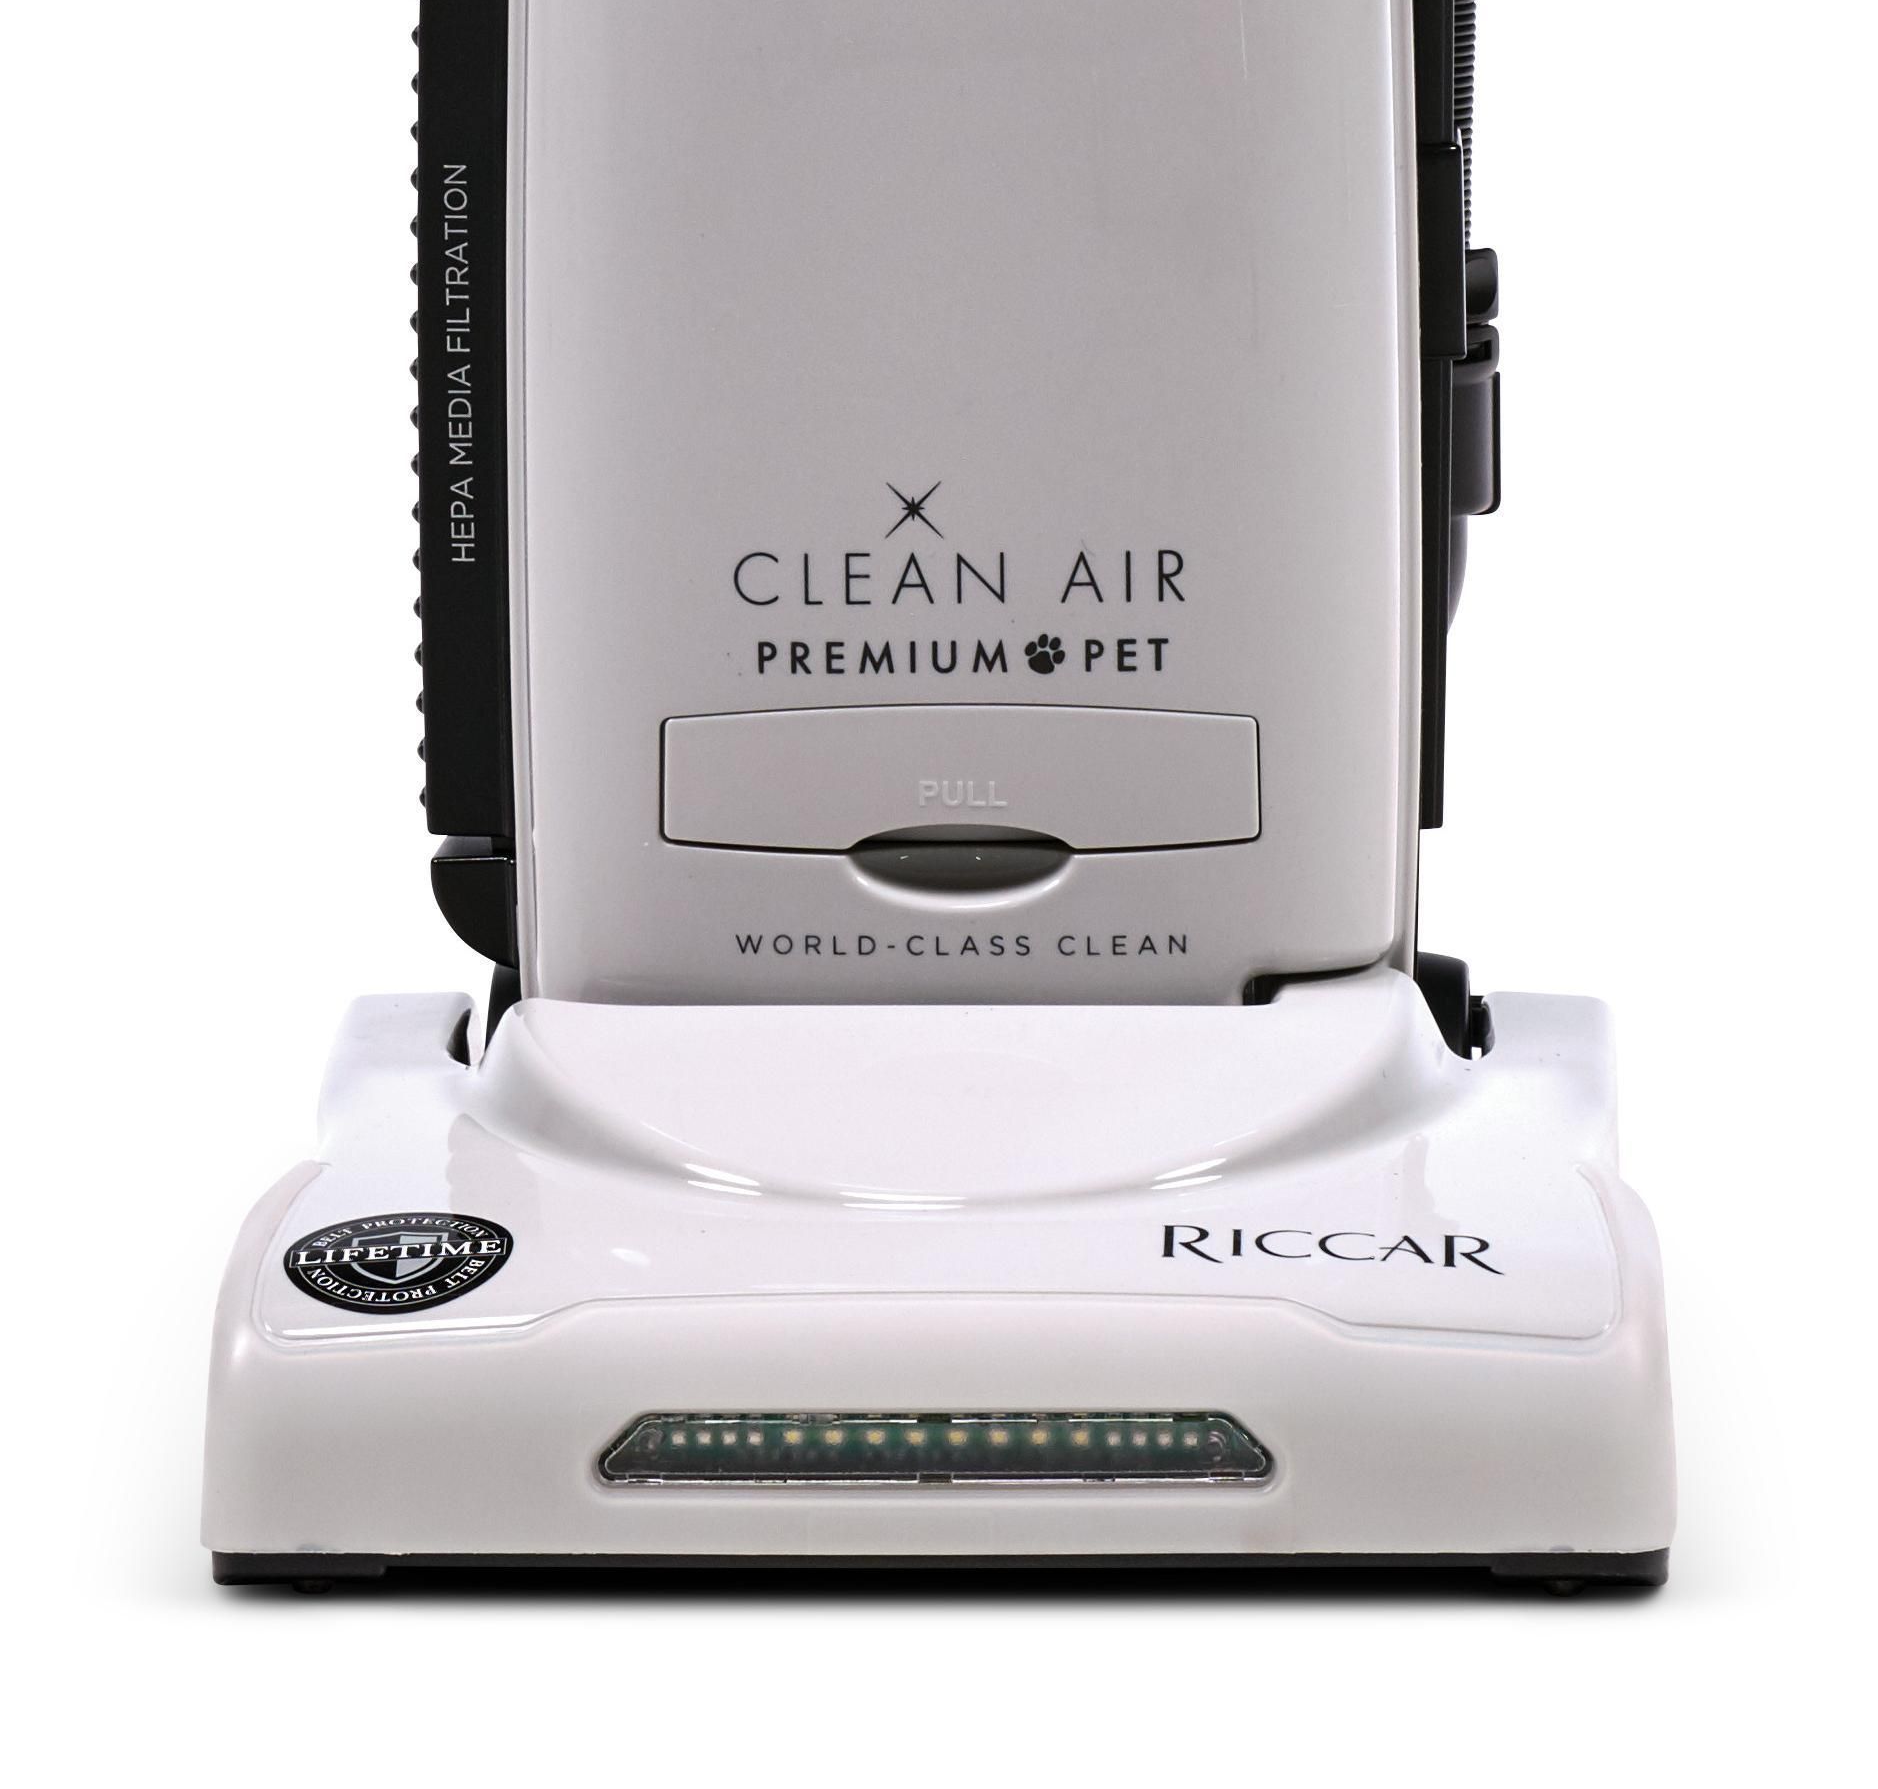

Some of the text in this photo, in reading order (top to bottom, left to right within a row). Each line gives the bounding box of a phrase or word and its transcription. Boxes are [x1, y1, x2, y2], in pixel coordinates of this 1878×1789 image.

[443, 164, 476, 562] HEPA MEDIA FILTRATION
[733, 549, 1186, 606] CLEAN AIR
[757, 637, 1170, 675] PREMIUM PET
[918, 779, 1008, 808] PULL
[735, 934, 1189, 958] WORLD-CLASS CLEAN
[312, 1216, 489, 1248] BELT PROTECTION
[1161, 1224, 1505, 1276] RICCAR
[297, 1239, 503, 1265] LIFETIME
[309, 1258, 485, 1302] BELT PROTECTION
